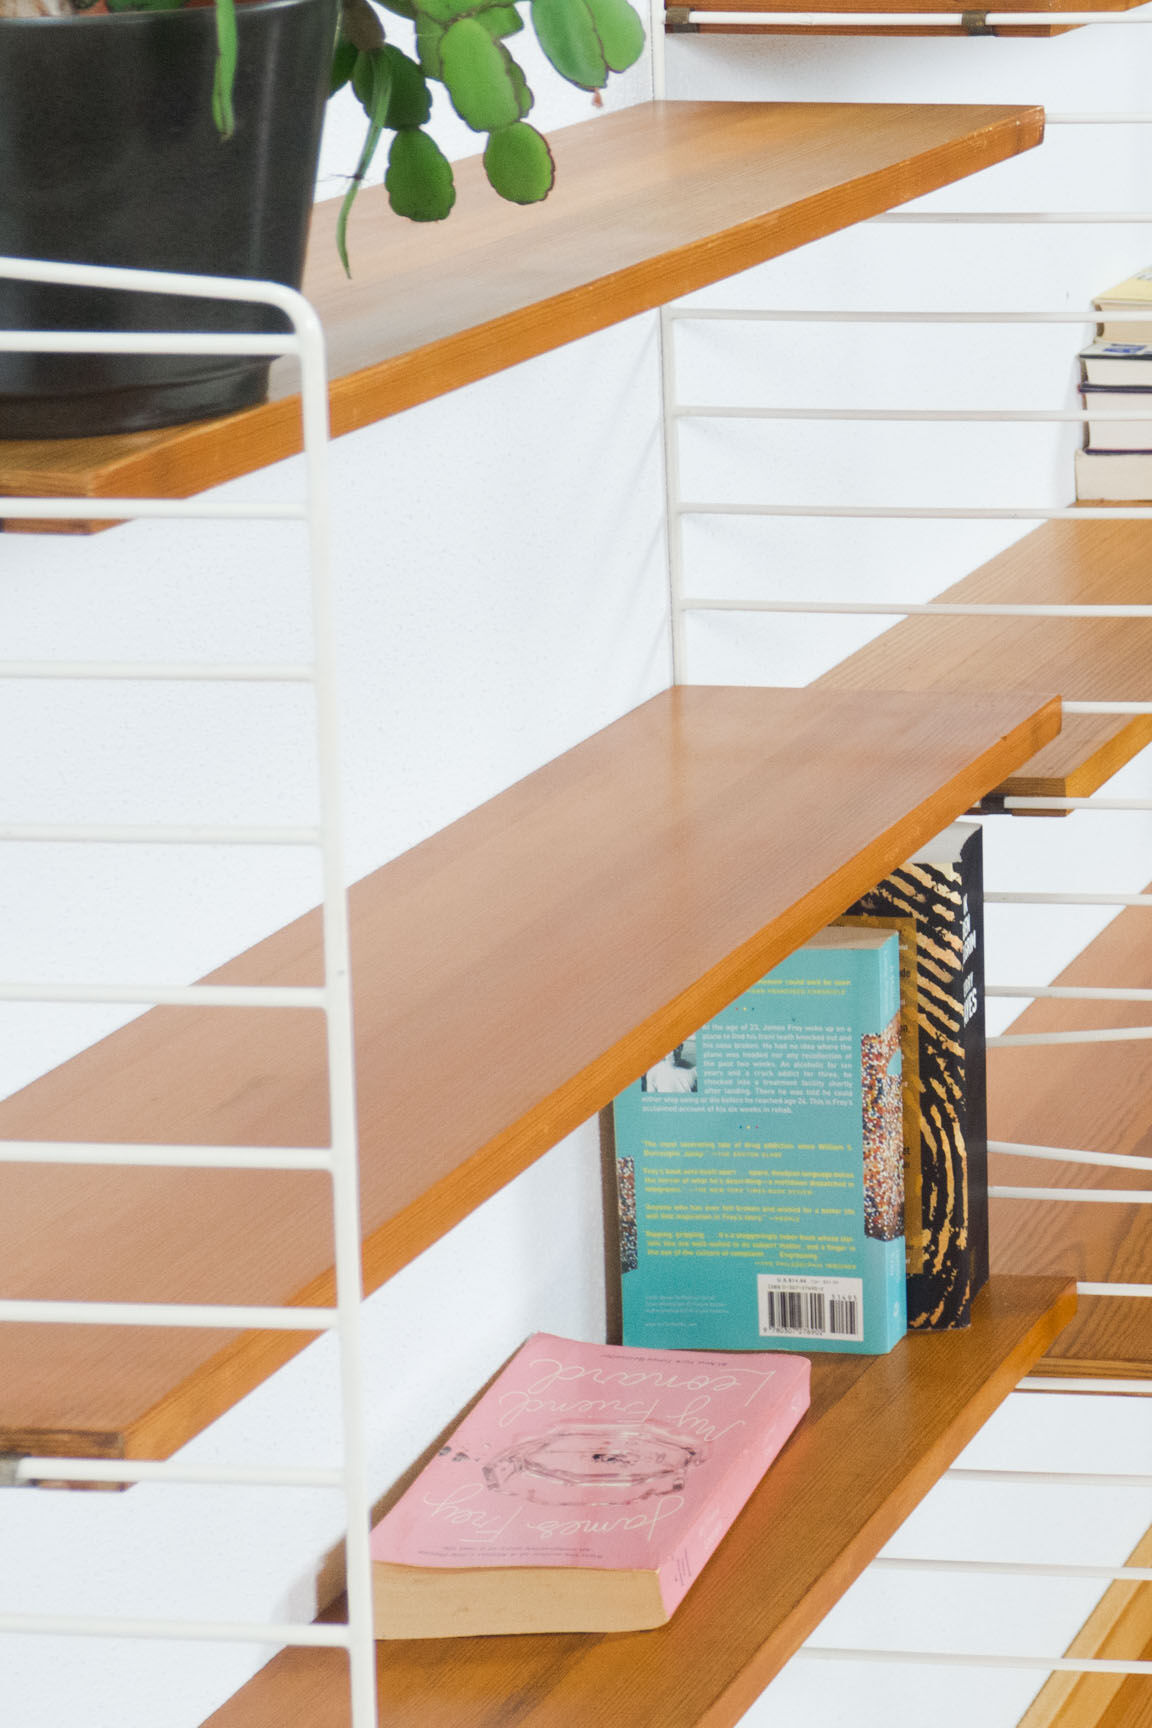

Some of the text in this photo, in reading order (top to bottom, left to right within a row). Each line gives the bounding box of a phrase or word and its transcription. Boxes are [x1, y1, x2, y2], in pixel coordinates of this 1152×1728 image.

[528, 1358, 777, 1407] Leonard
[498, 1391, 663, 1428] Friend
[666, 1395, 747, 1443] My
[424, 1482, 519, 1543] Frey
[528, 1494, 685, 1542] James
